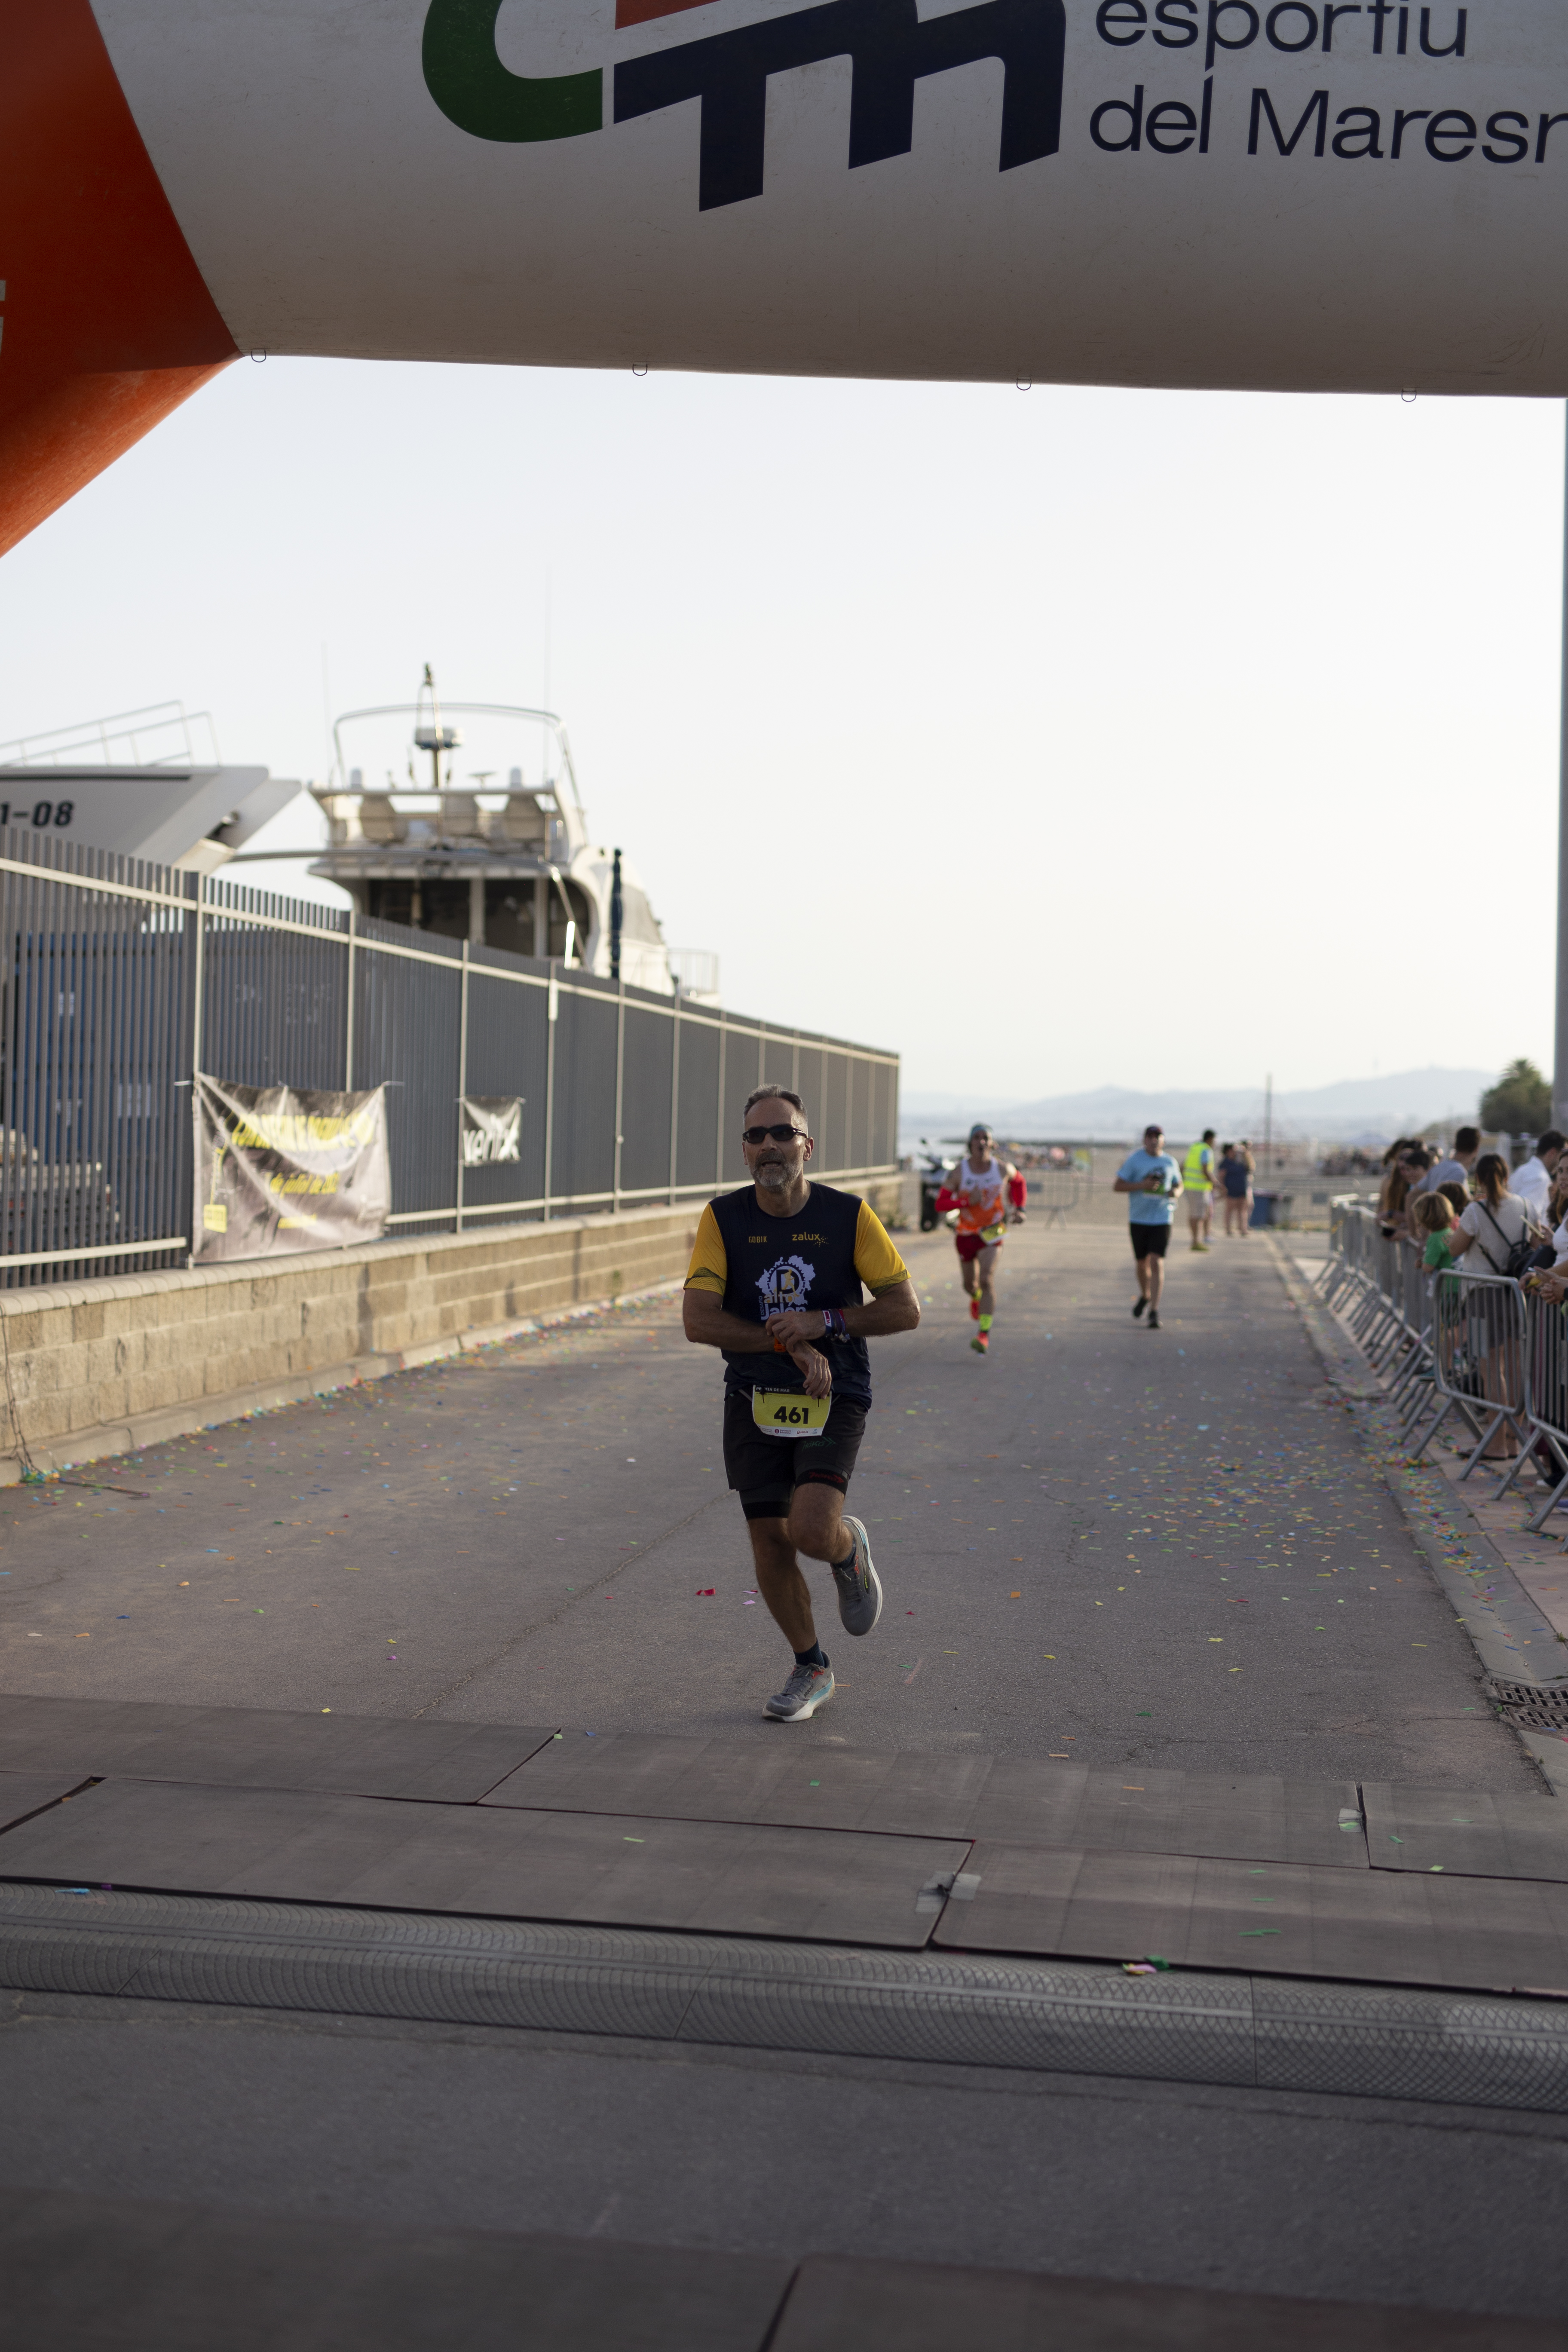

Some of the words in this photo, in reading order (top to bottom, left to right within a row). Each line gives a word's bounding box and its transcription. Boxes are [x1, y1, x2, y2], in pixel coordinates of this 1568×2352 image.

[1096, 0, 1467, 71] esportiu
[1090, 77, 1213, 154] del
[792, 1232, 821, 1241] zalux
[774, 1406, 808, 1424] 461
